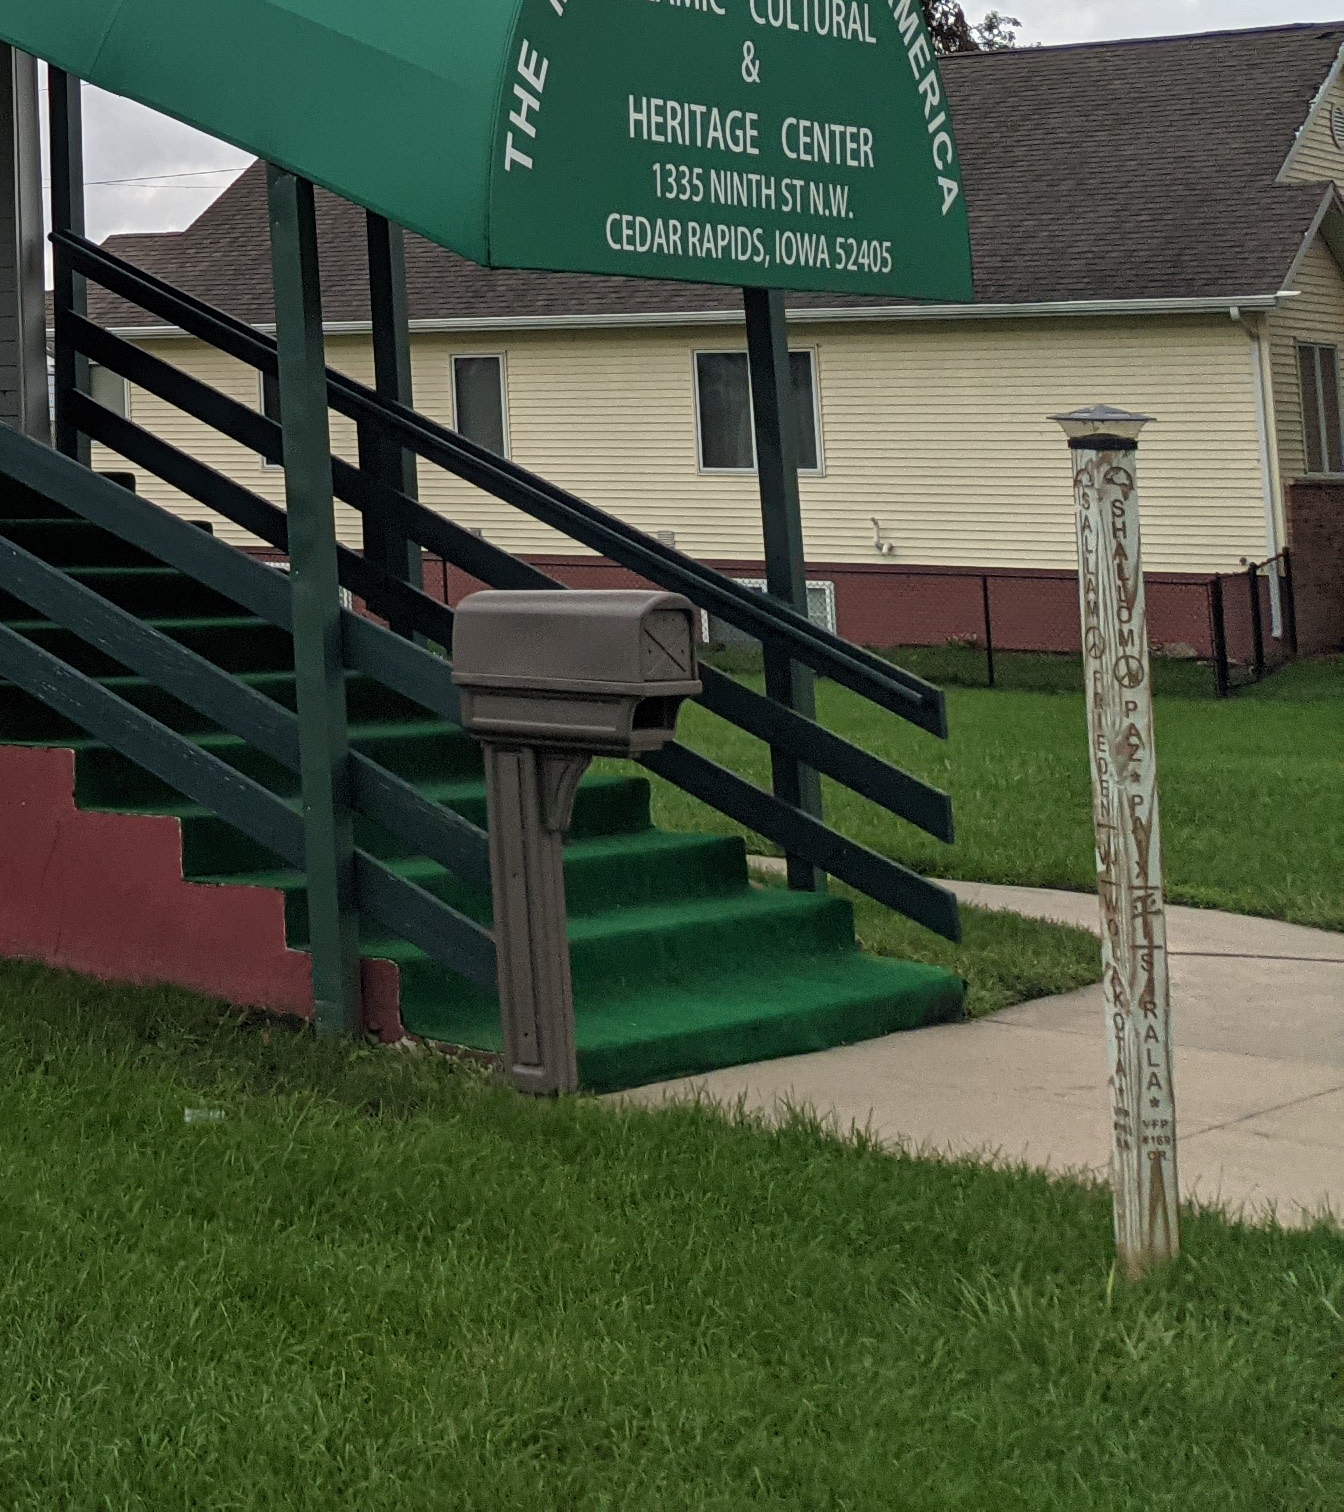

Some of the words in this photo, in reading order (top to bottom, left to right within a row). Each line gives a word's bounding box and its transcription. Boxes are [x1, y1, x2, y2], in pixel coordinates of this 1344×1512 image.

[742, 41, 760, 82] &
[505, 39, 548, 171] THE
[629, 95, 759, 154] HERITAGE
[782, 118, 873, 167] CENTER
[653, 163, 703, 201] 1335
[711, 170, 775, 209] NINTH
[782, 179, 804, 212] ST
[810, 182, 853, 218] N.W.
[606, 213, 682, 254] CEDAR
[688, 222, 769, 267] RAPIDS,
[776, 231, 830, 268] IOWA
[836, 238, 891, 272] 52405
